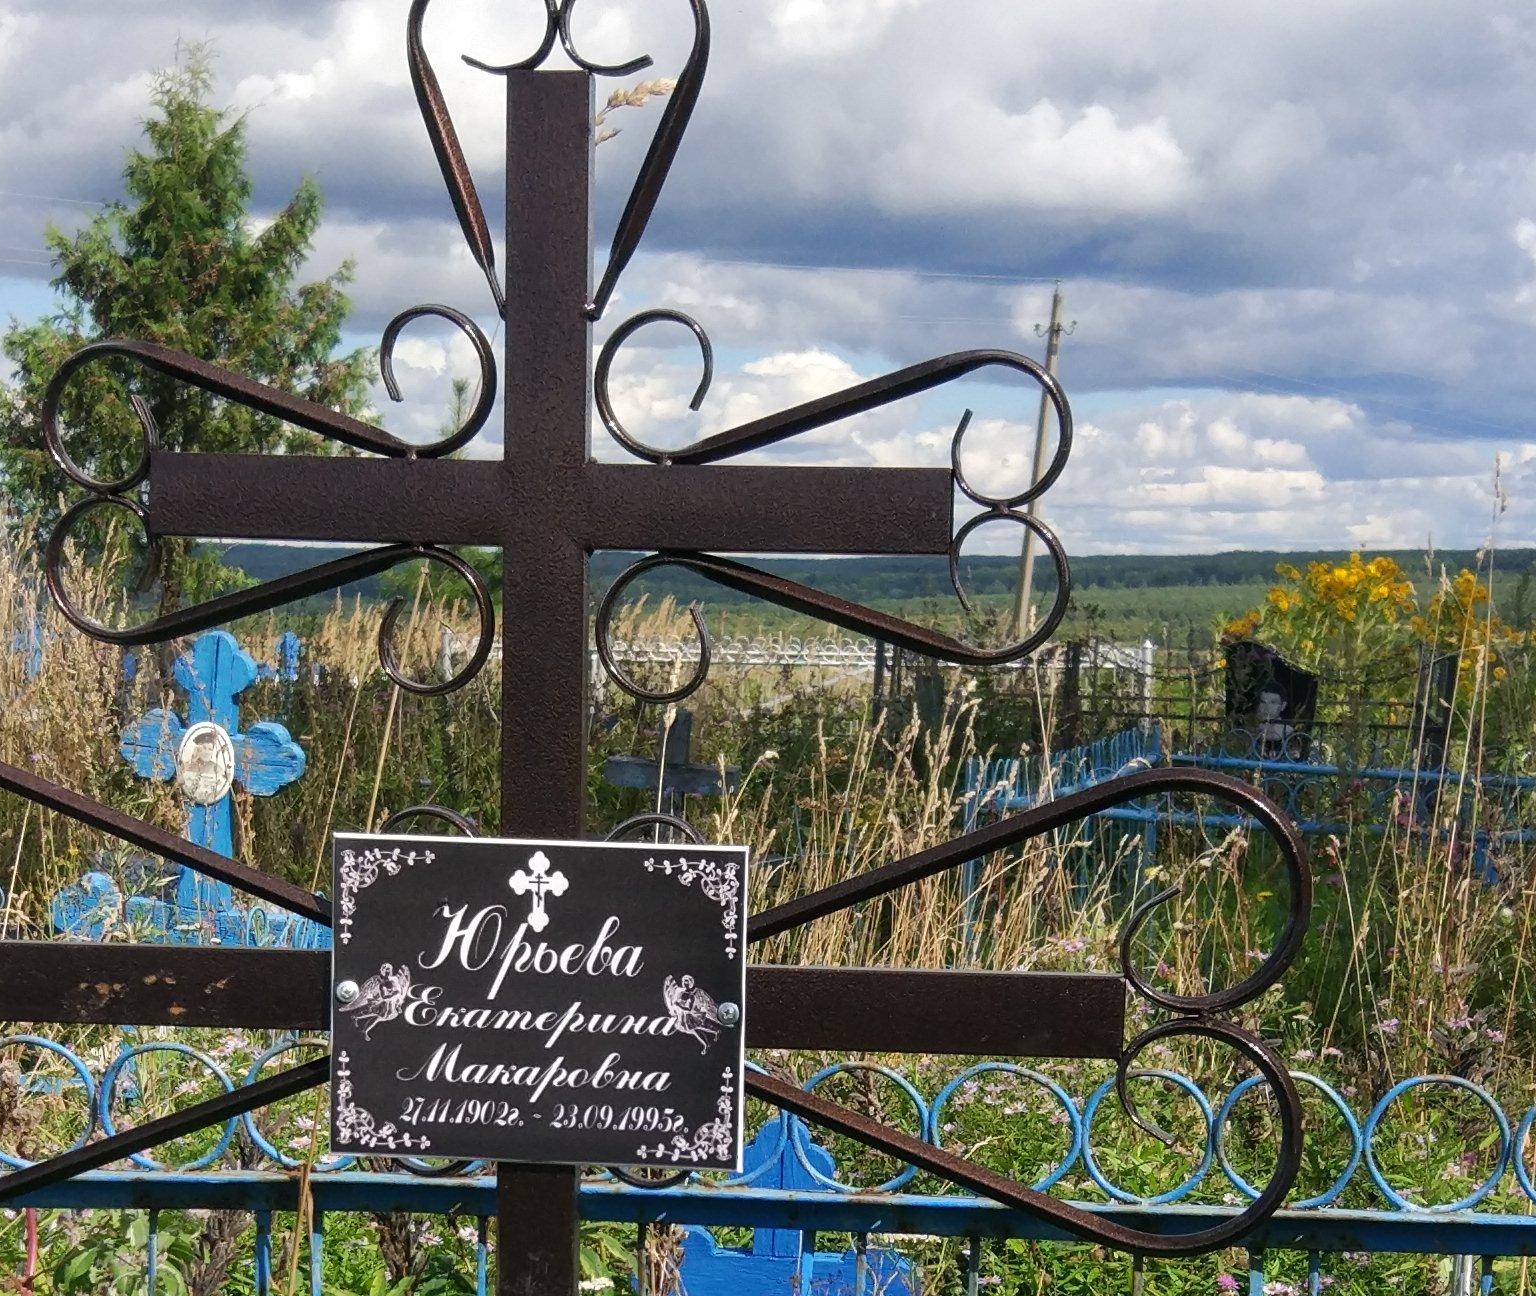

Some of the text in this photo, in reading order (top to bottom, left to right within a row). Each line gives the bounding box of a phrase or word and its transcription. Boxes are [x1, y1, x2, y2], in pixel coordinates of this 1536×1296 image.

[418, 904, 645, 1000] Юрьева
[404, 984, 678, 1048] Екатерина
[396, 1043, 673, 1103] Макаровна
